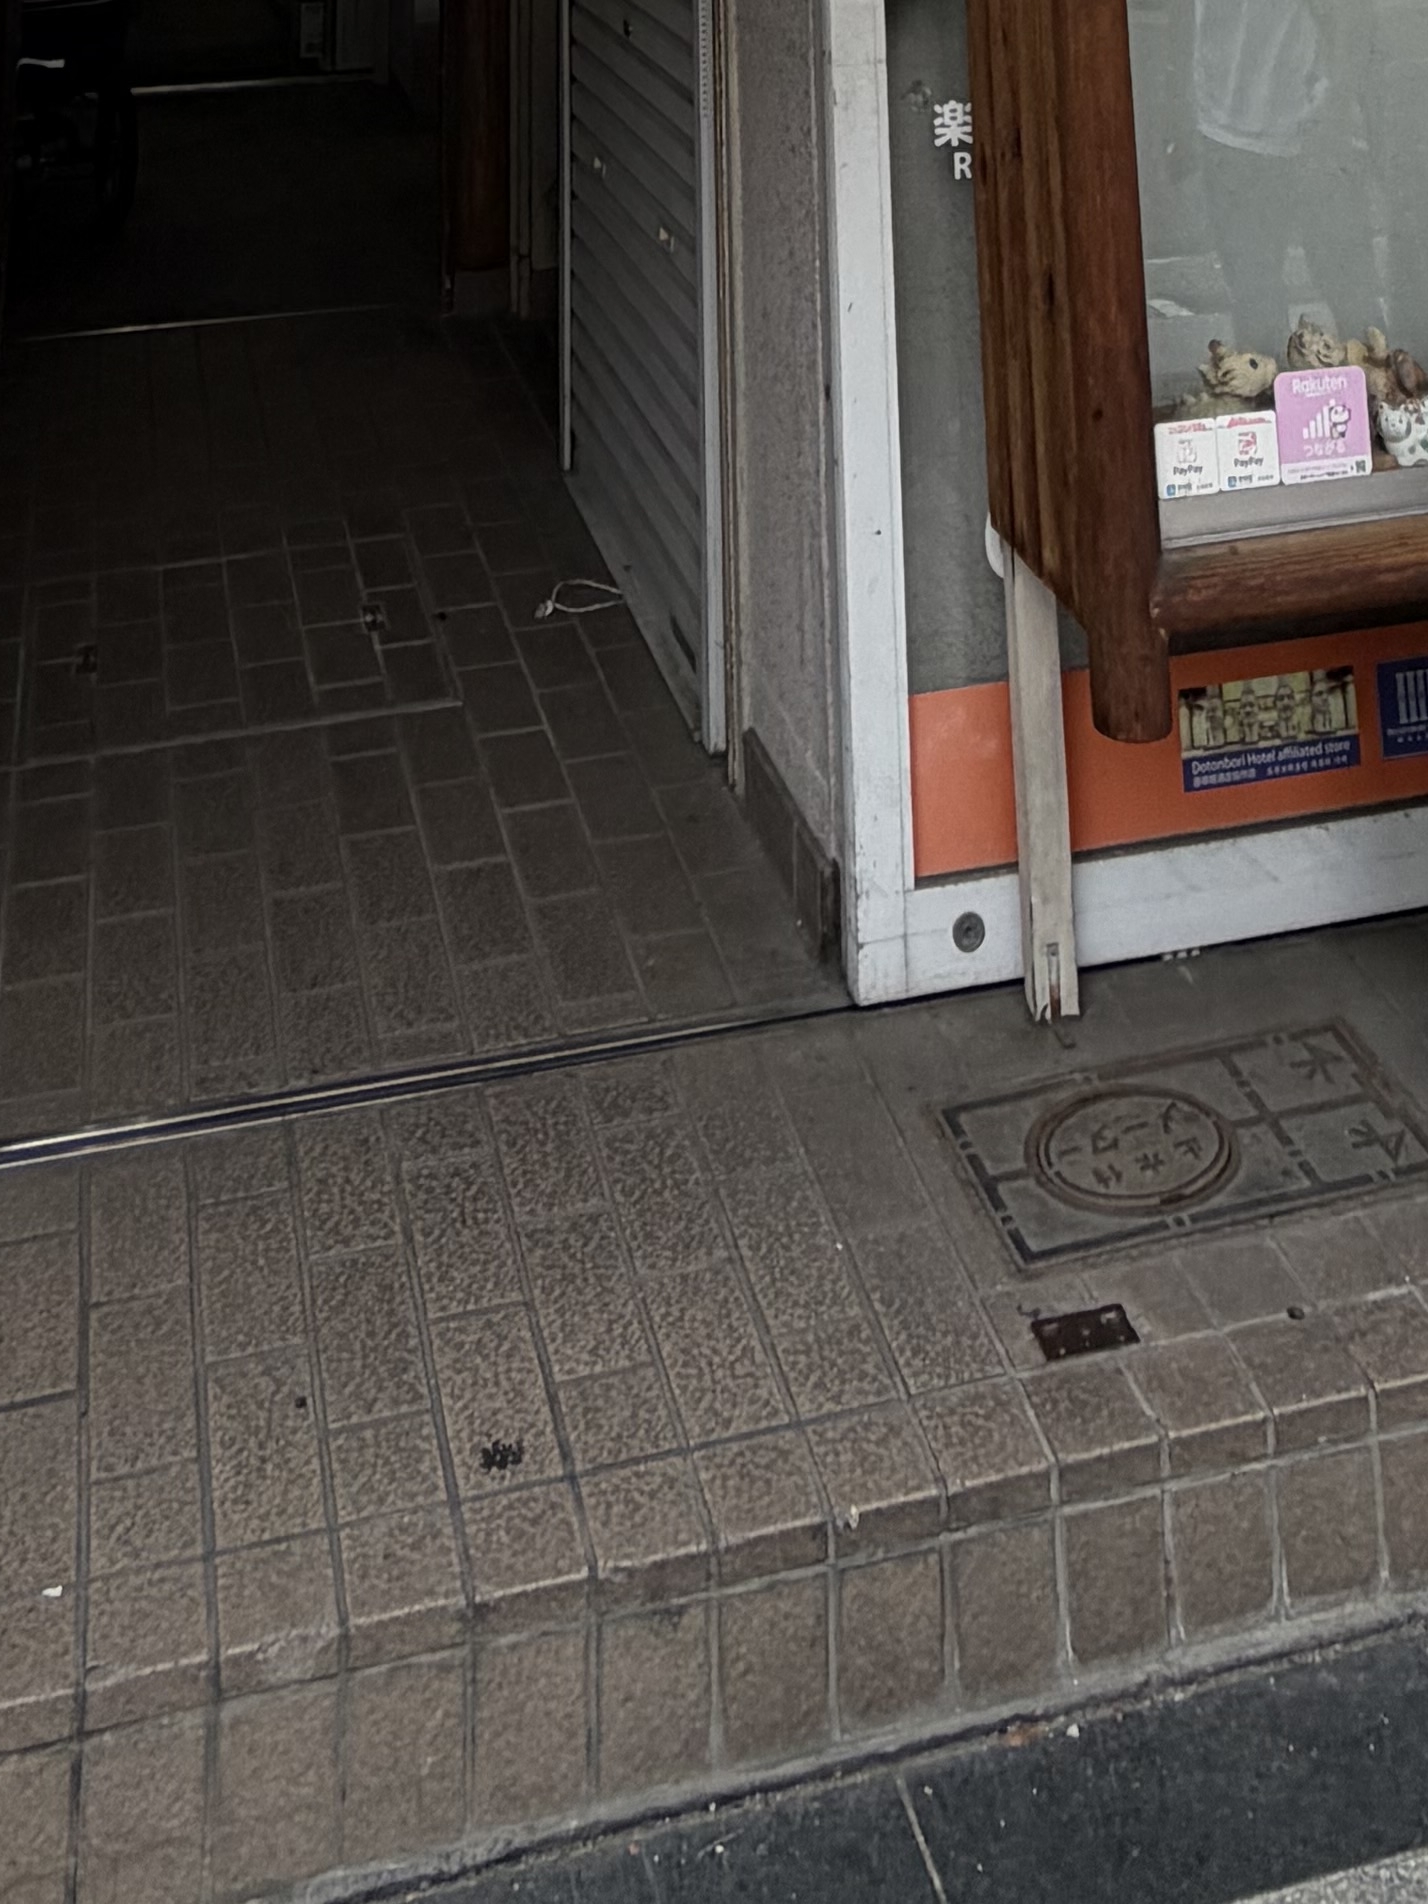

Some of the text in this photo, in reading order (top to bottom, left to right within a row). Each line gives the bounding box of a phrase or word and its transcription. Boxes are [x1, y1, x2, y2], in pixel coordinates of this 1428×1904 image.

[1292, 374, 1348, 395] Rakuten
[1172, 464, 1204, 476] PayPay
[1233, 456, 1265, 469] PayPay
[1191, 755, 1246, 775] Dotonbori
[1246, 751, 1276, 769] Hotel
[1276, 744, 1323, 764] affiliated
[1323, 740, 1351, 756] store
